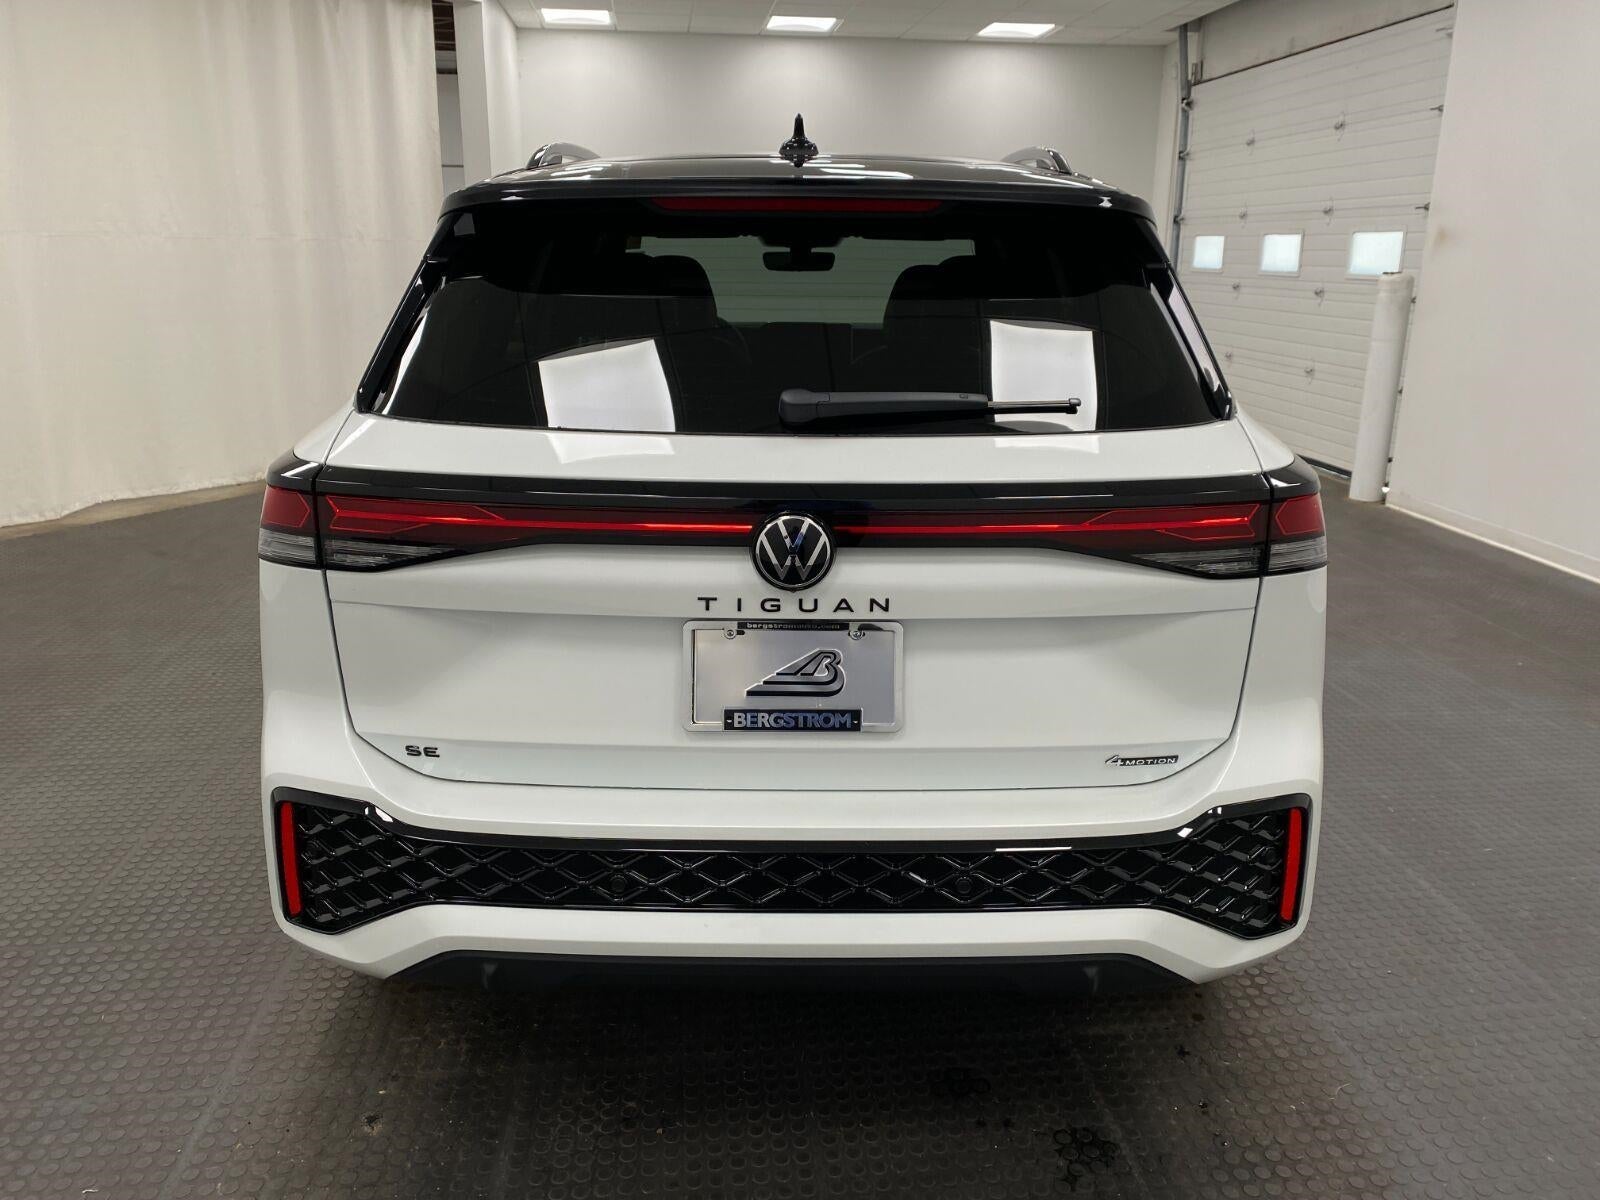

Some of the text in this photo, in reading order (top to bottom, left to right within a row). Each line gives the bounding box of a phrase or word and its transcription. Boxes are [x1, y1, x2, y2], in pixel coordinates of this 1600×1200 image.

[697, 597, 891, 613] TIGUAN
[733, 712, 852, 728] BERGSTROM
[405, 745, 440, 758] SE
[1105, 755, 1178, 767] 4MOTION
